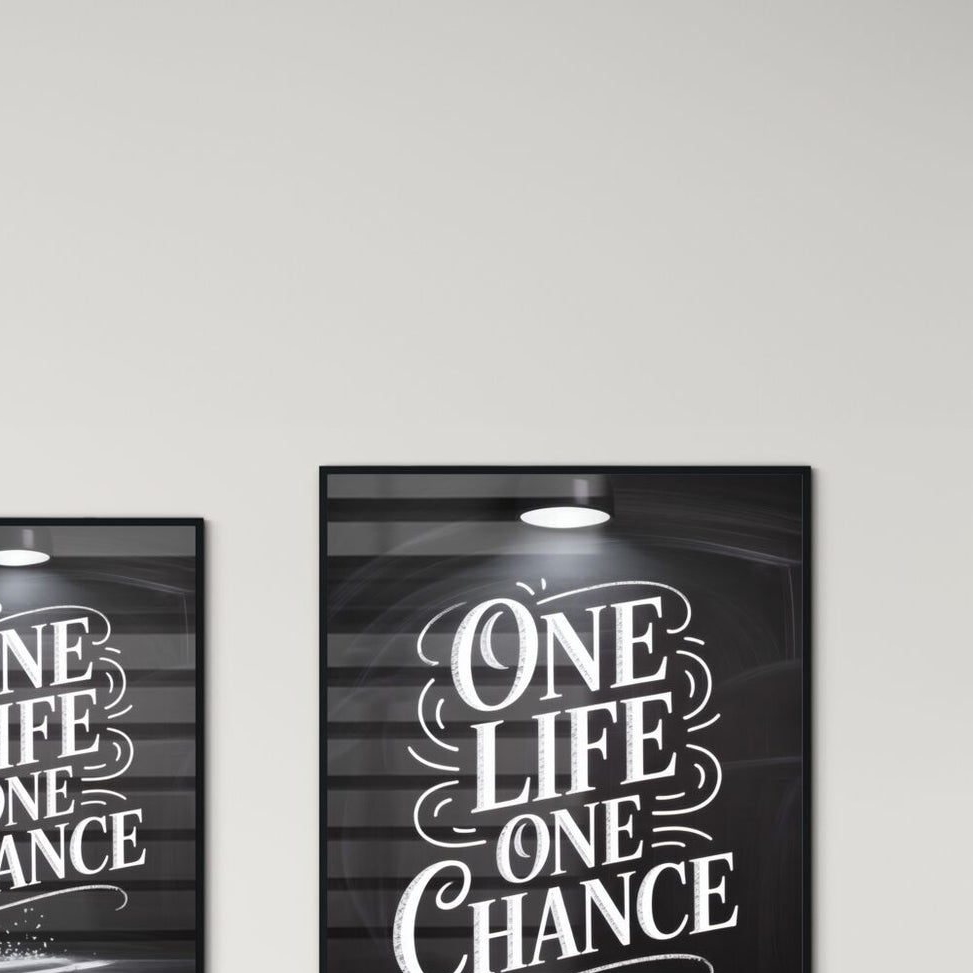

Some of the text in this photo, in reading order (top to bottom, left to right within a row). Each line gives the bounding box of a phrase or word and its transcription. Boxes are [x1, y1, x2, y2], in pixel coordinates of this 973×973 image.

[450, 596, 668, 712] ONE
[470, 691, 677, 814] LIFE
[495, 794, 644, 884] ONE
